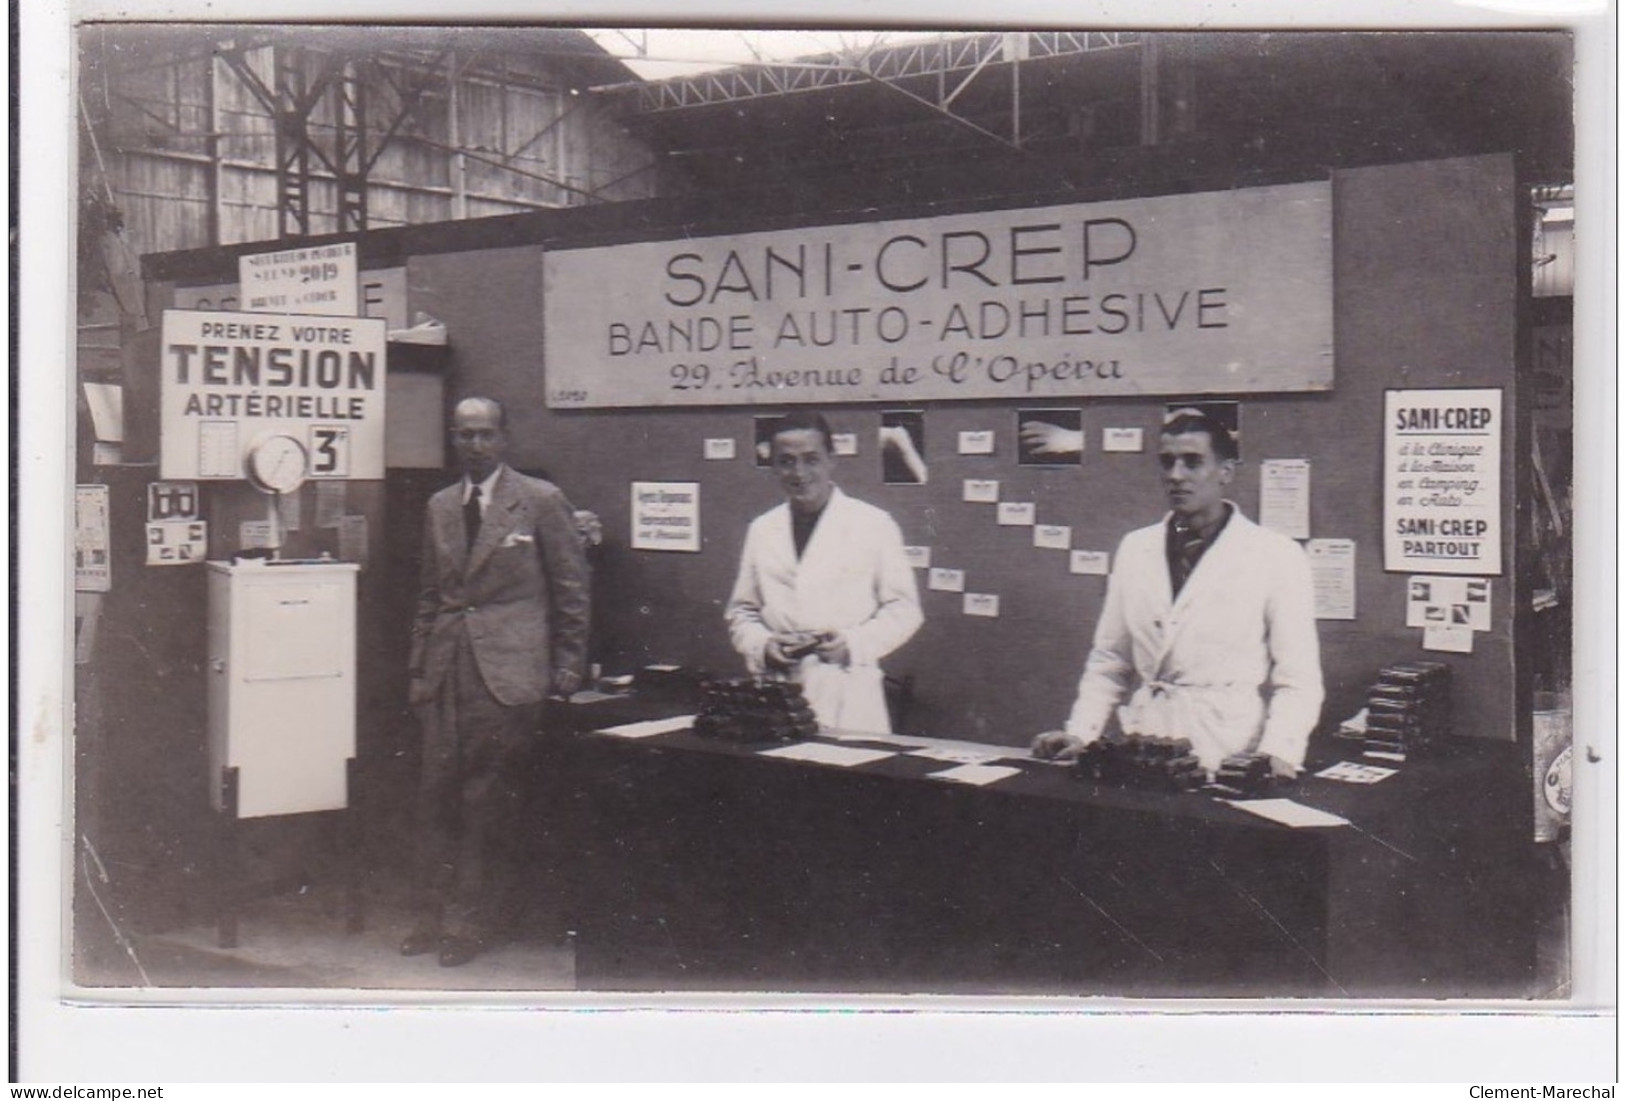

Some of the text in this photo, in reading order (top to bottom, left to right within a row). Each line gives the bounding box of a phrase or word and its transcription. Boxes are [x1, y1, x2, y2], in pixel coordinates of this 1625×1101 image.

[665, 218, 1137, 306] SANI-CREP
[201, 322, 353, 344] PRENEZ VOTRE
[609, 288, 1229, 356] BANDE AUTO-ADHESIVE
[168, 344, 375, 390] TENSION
[730, 357, 862, 388] Avenue
[880, 357, 919, 385] de
[184, 390, 365, 419] ARTÉRIELLE
[1396, 408, 1491, 430] SANI-CREP
[1418, 477, 1480, 496] Camping
[1396, 518, 1487, 536] SANI-CREP
[1403, 540, 1480, 556] PARTOUT
